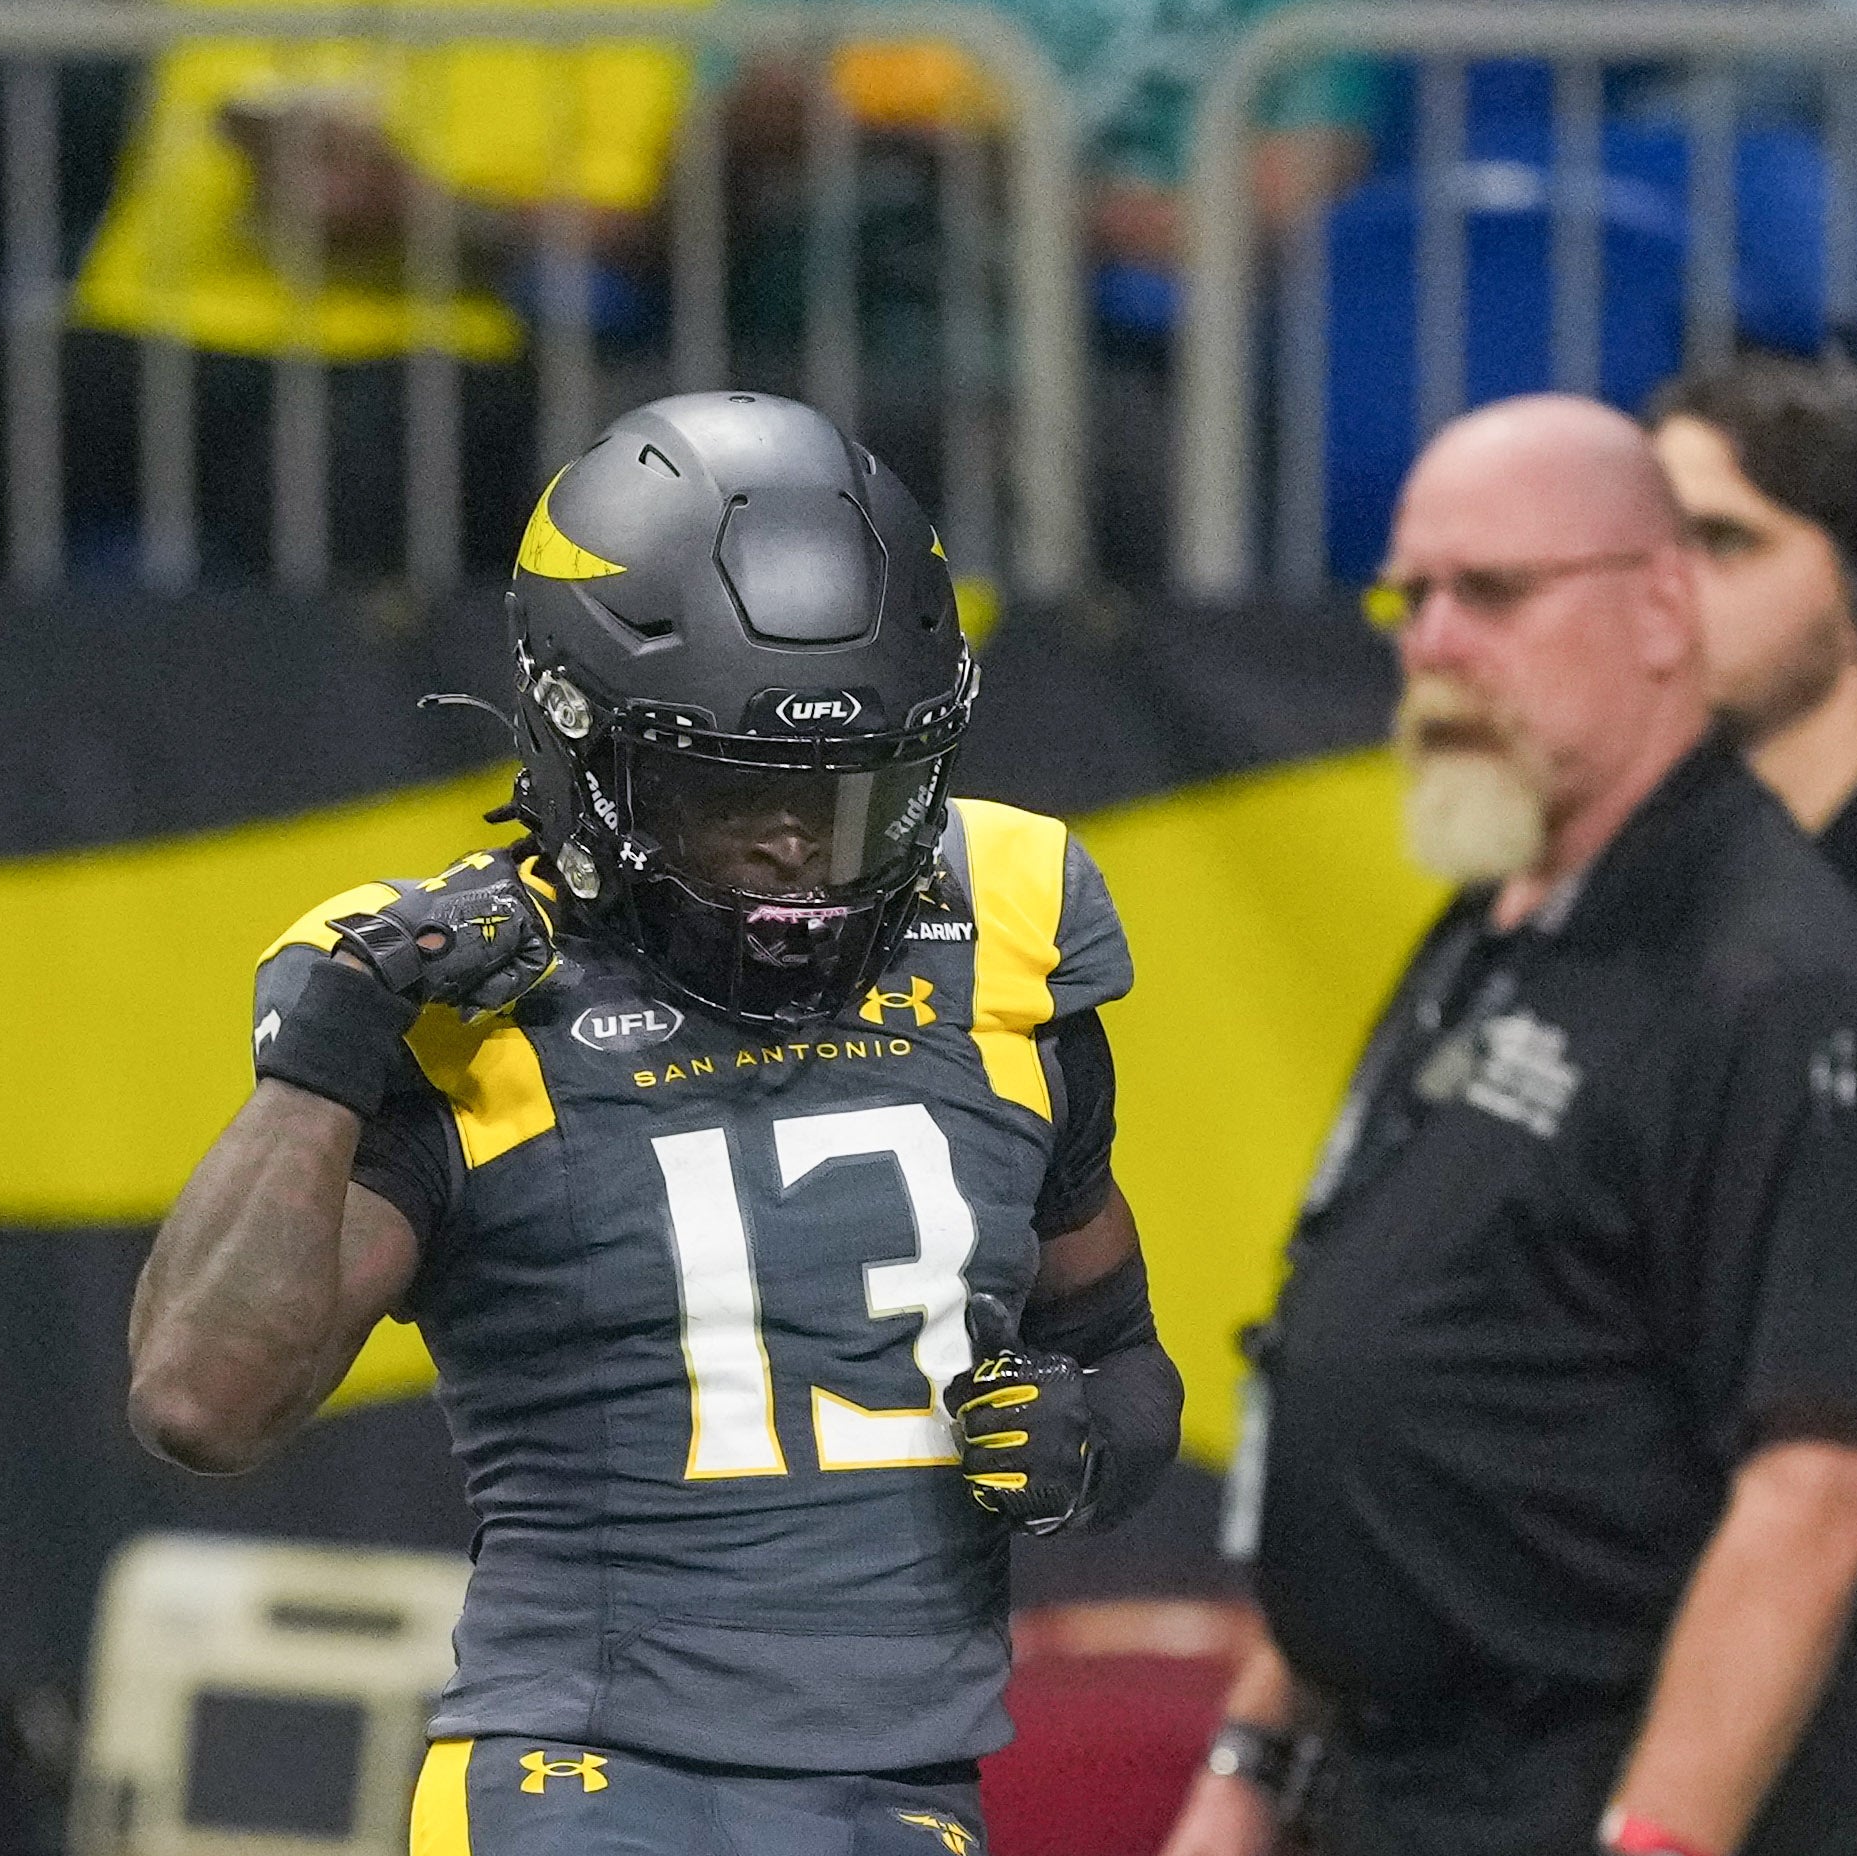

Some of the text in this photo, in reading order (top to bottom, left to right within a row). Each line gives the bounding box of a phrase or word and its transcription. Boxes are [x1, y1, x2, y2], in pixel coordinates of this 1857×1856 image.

[792, 700, 848, 719] UFL
[585, 770, 618, 831] Ridd
[592, 1009, 668, 1039] UFL
[633, 1038, 913, 1088] SAN ANTONIO
[650, 1102, 980, 1481] 13
